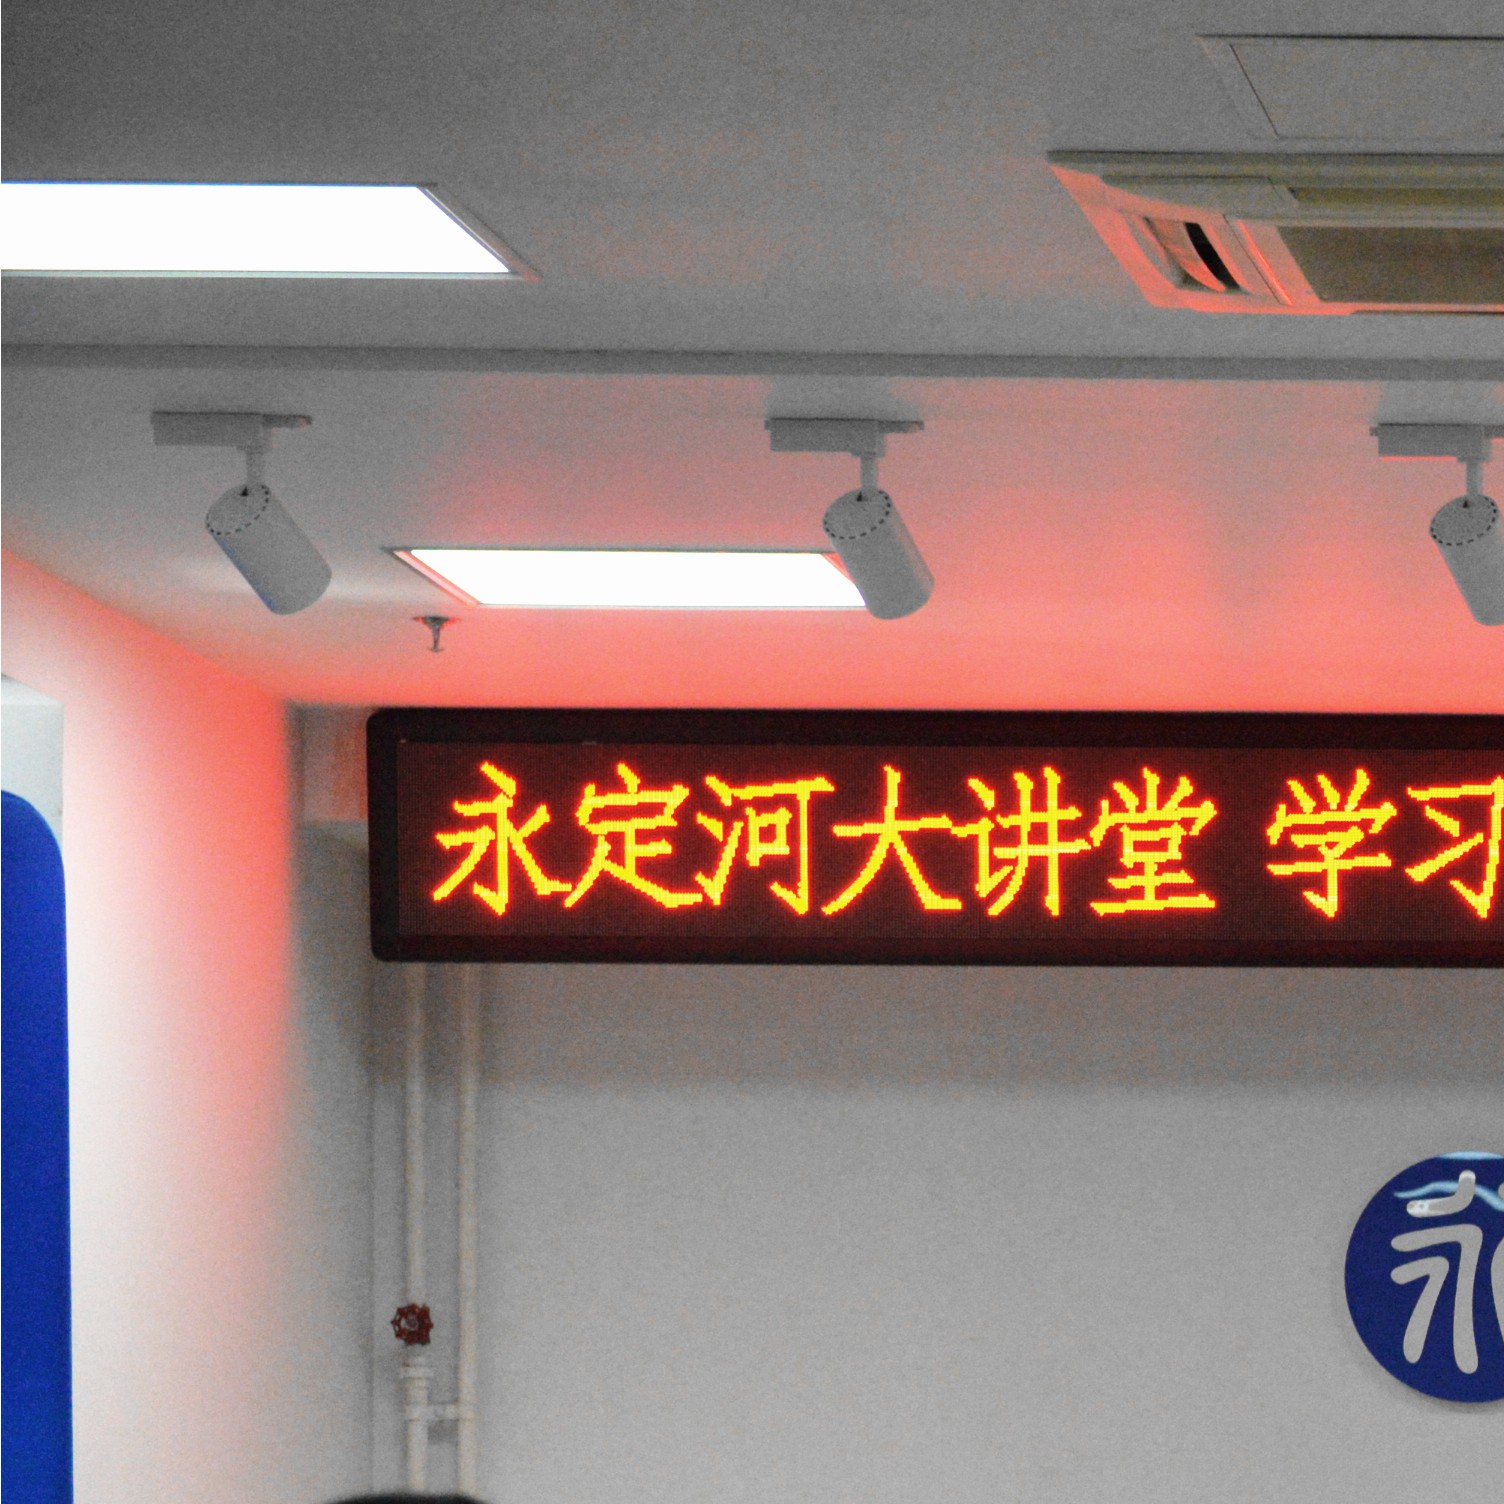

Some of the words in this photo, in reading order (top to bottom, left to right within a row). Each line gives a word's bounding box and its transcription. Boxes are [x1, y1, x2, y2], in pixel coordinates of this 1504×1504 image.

[430, 762, 1217, 917] 永定河大讲堂
